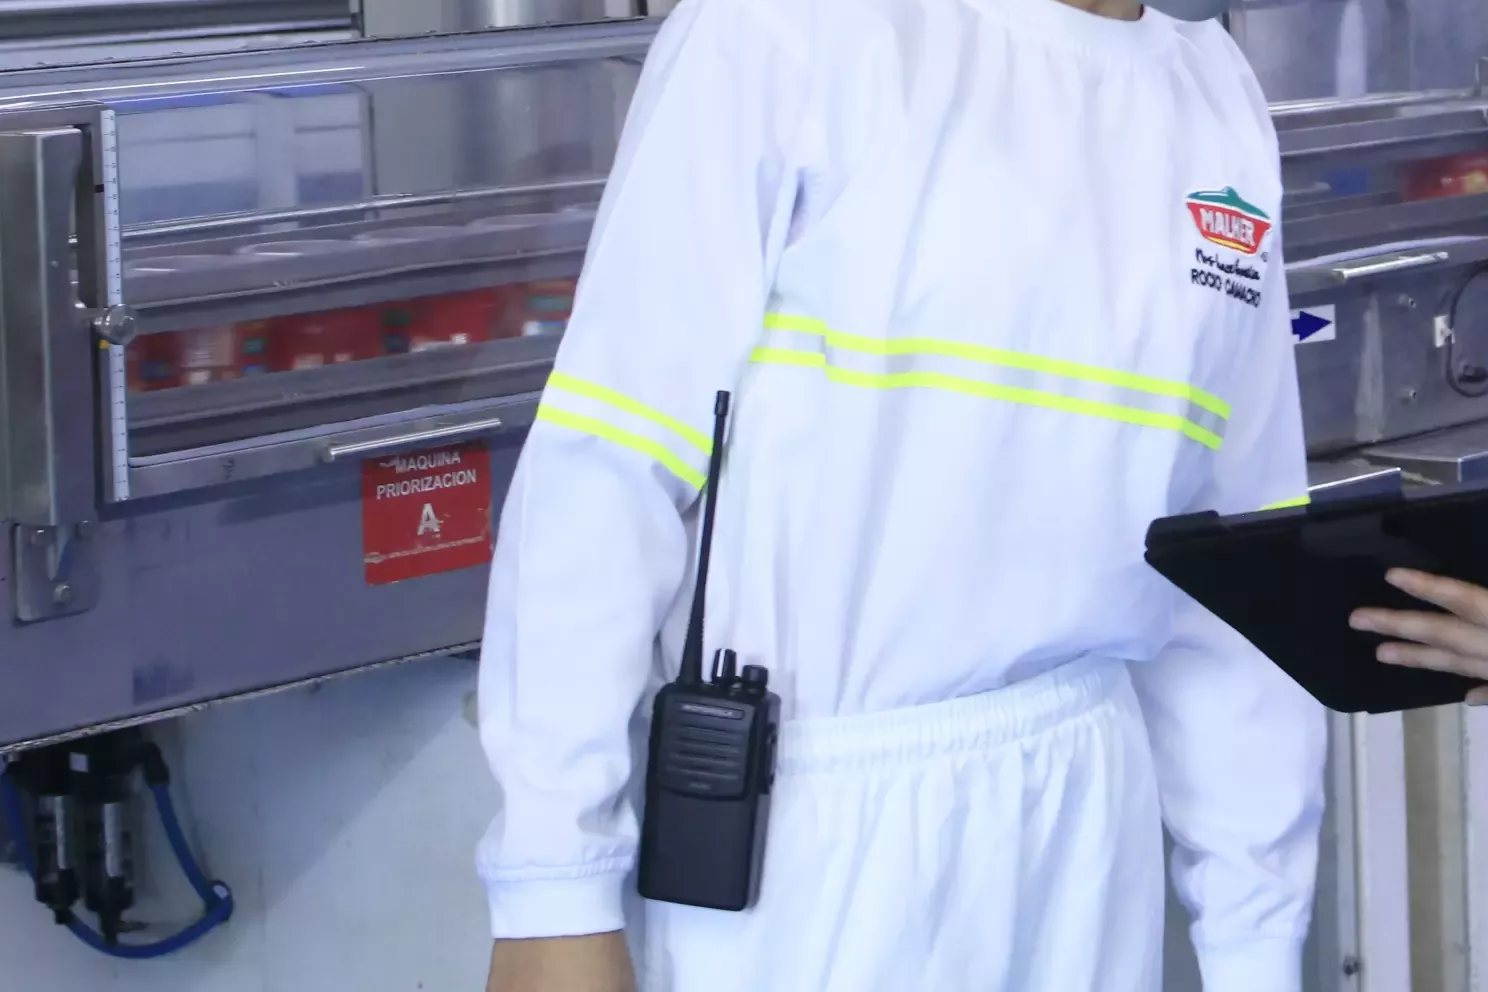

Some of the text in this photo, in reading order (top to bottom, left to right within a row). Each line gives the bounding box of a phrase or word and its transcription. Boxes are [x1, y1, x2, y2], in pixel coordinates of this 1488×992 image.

[1199, 208, 1256, 247] MALHER
[395, 451, 461, 474] MAQUINA
[376, 469, 477, 500] PRIORIZACION
[417, 503, 441, 536] A
